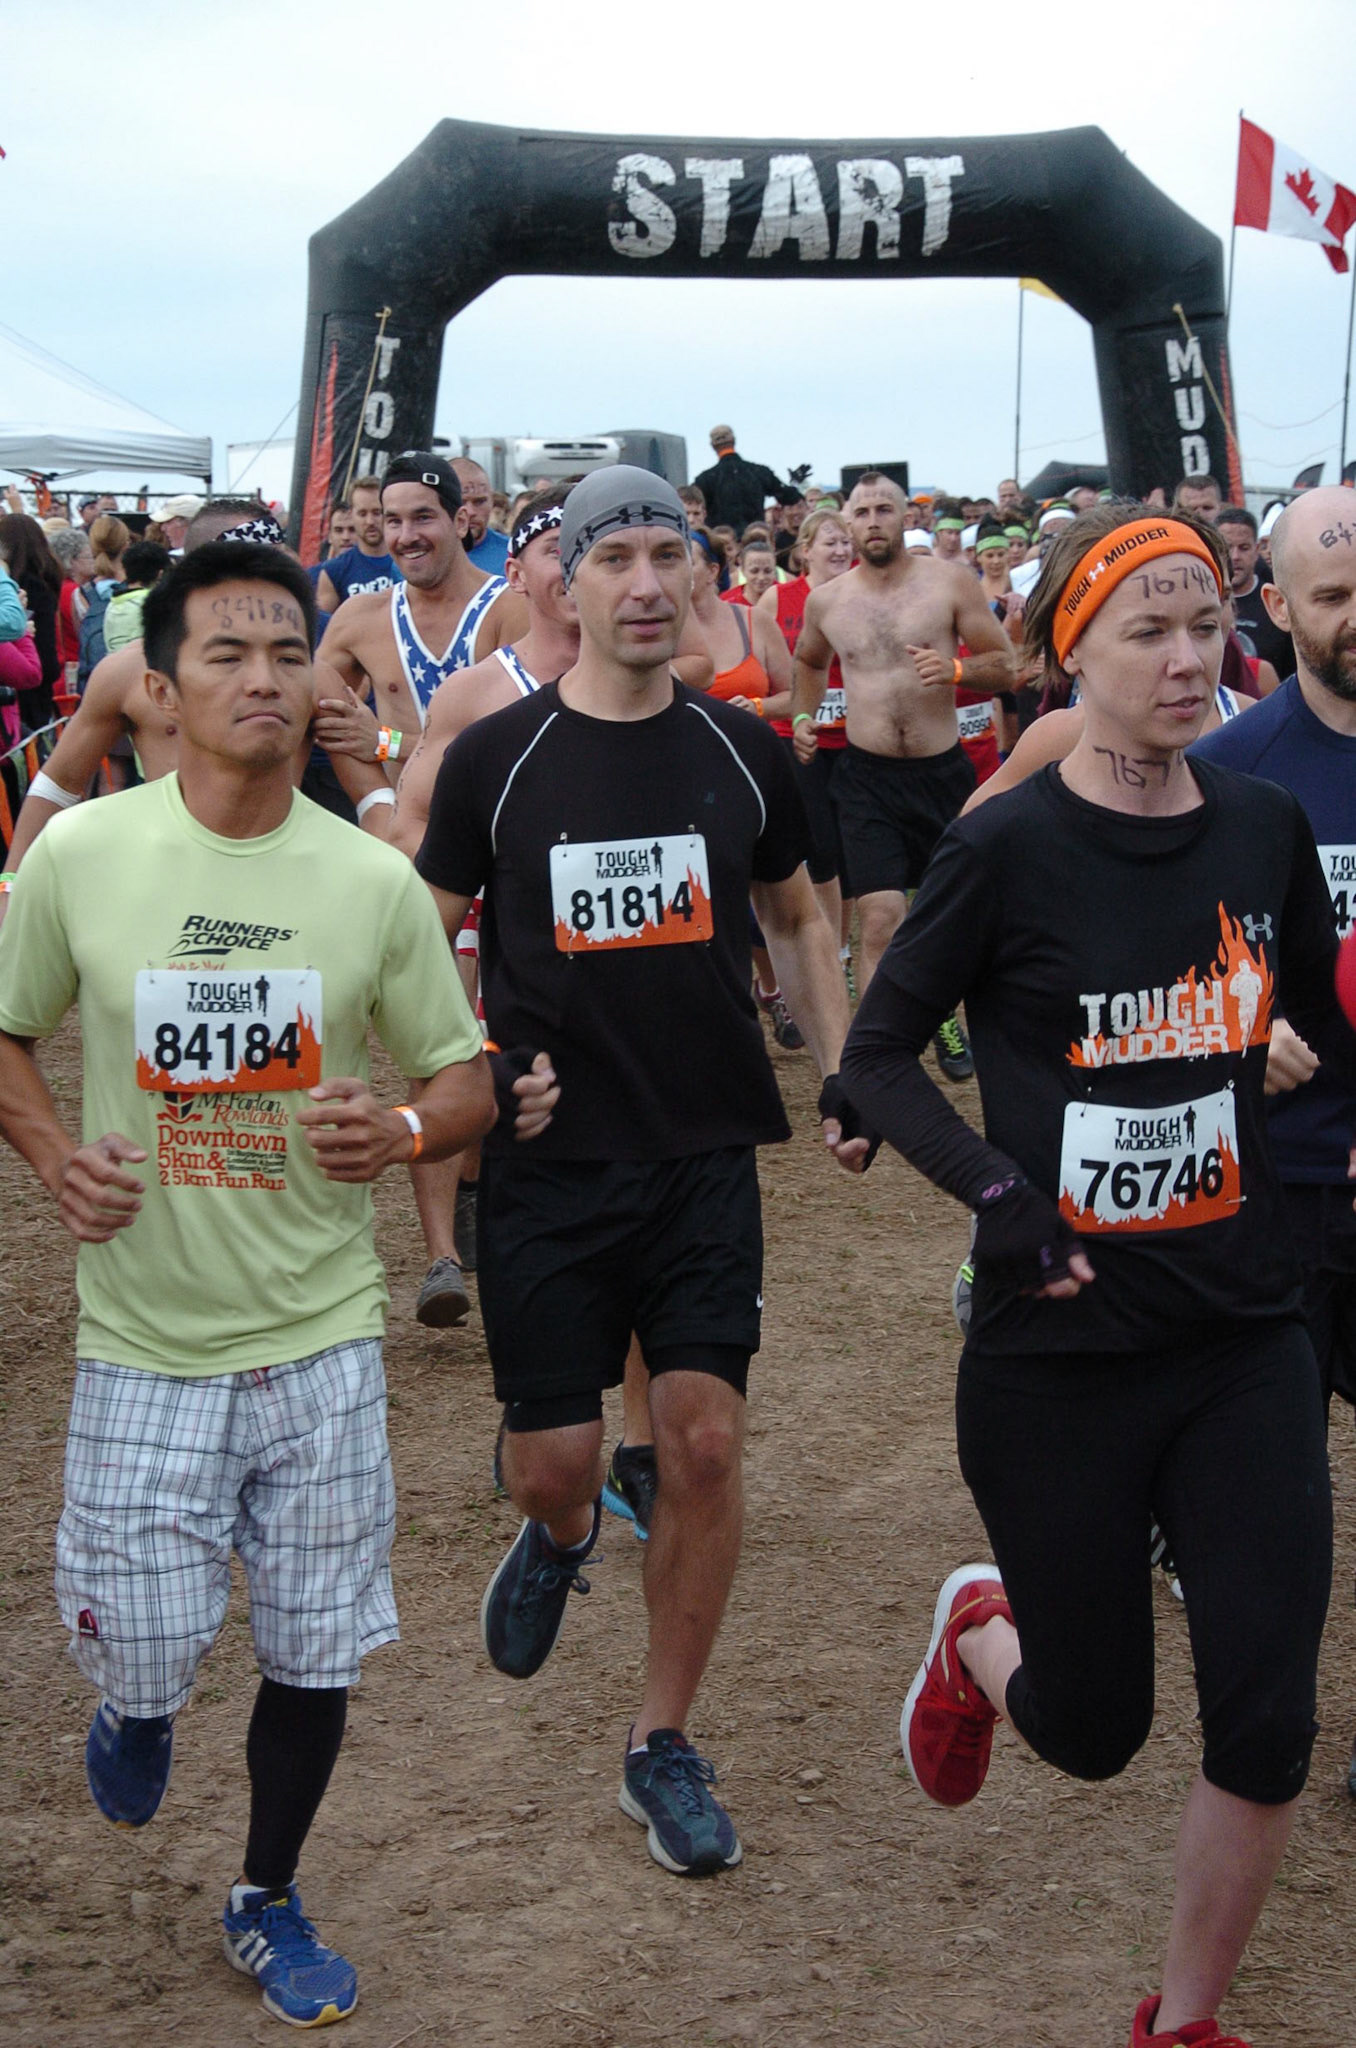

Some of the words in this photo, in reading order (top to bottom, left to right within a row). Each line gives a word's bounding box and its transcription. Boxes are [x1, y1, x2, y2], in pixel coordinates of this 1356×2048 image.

[607, 153, 965, 260] START
[1319, 521, 1356, 548] 84
[1064, 576, 1091, 616] TOUGH
[1103, 527, 1169, 568] MUDDER
[595, 849, 648, 867] TOUGH
[595, 866, 650, 879] MUDDER
[571, 881, 694, 931] 81814
[192, 932, 273, 951] CHOICE
[187, 982, 250, 1000] TOUGH
[187, 1001, 252, 1013] MUDDER
[1079, 981, 1222, 1038] TOUGH
[155, 1022, 301, 1071] 84184
[1082, 1024, 1229, 1068] MUDDER
[158, 1125, 287, 1152] Downtown
[1115, 1116, 1180, 1138] TOUGH
[1115, 1136, 1182, 1151] MUDDER
[158, 1147, 205, 1170] 5km
[207, 1151, 226, 1171] &
[215, 1172, 249, 1189] Fun
[250, 1173, 287, 1191] Run
[1080, 1148, 1223, 1209] 76746
